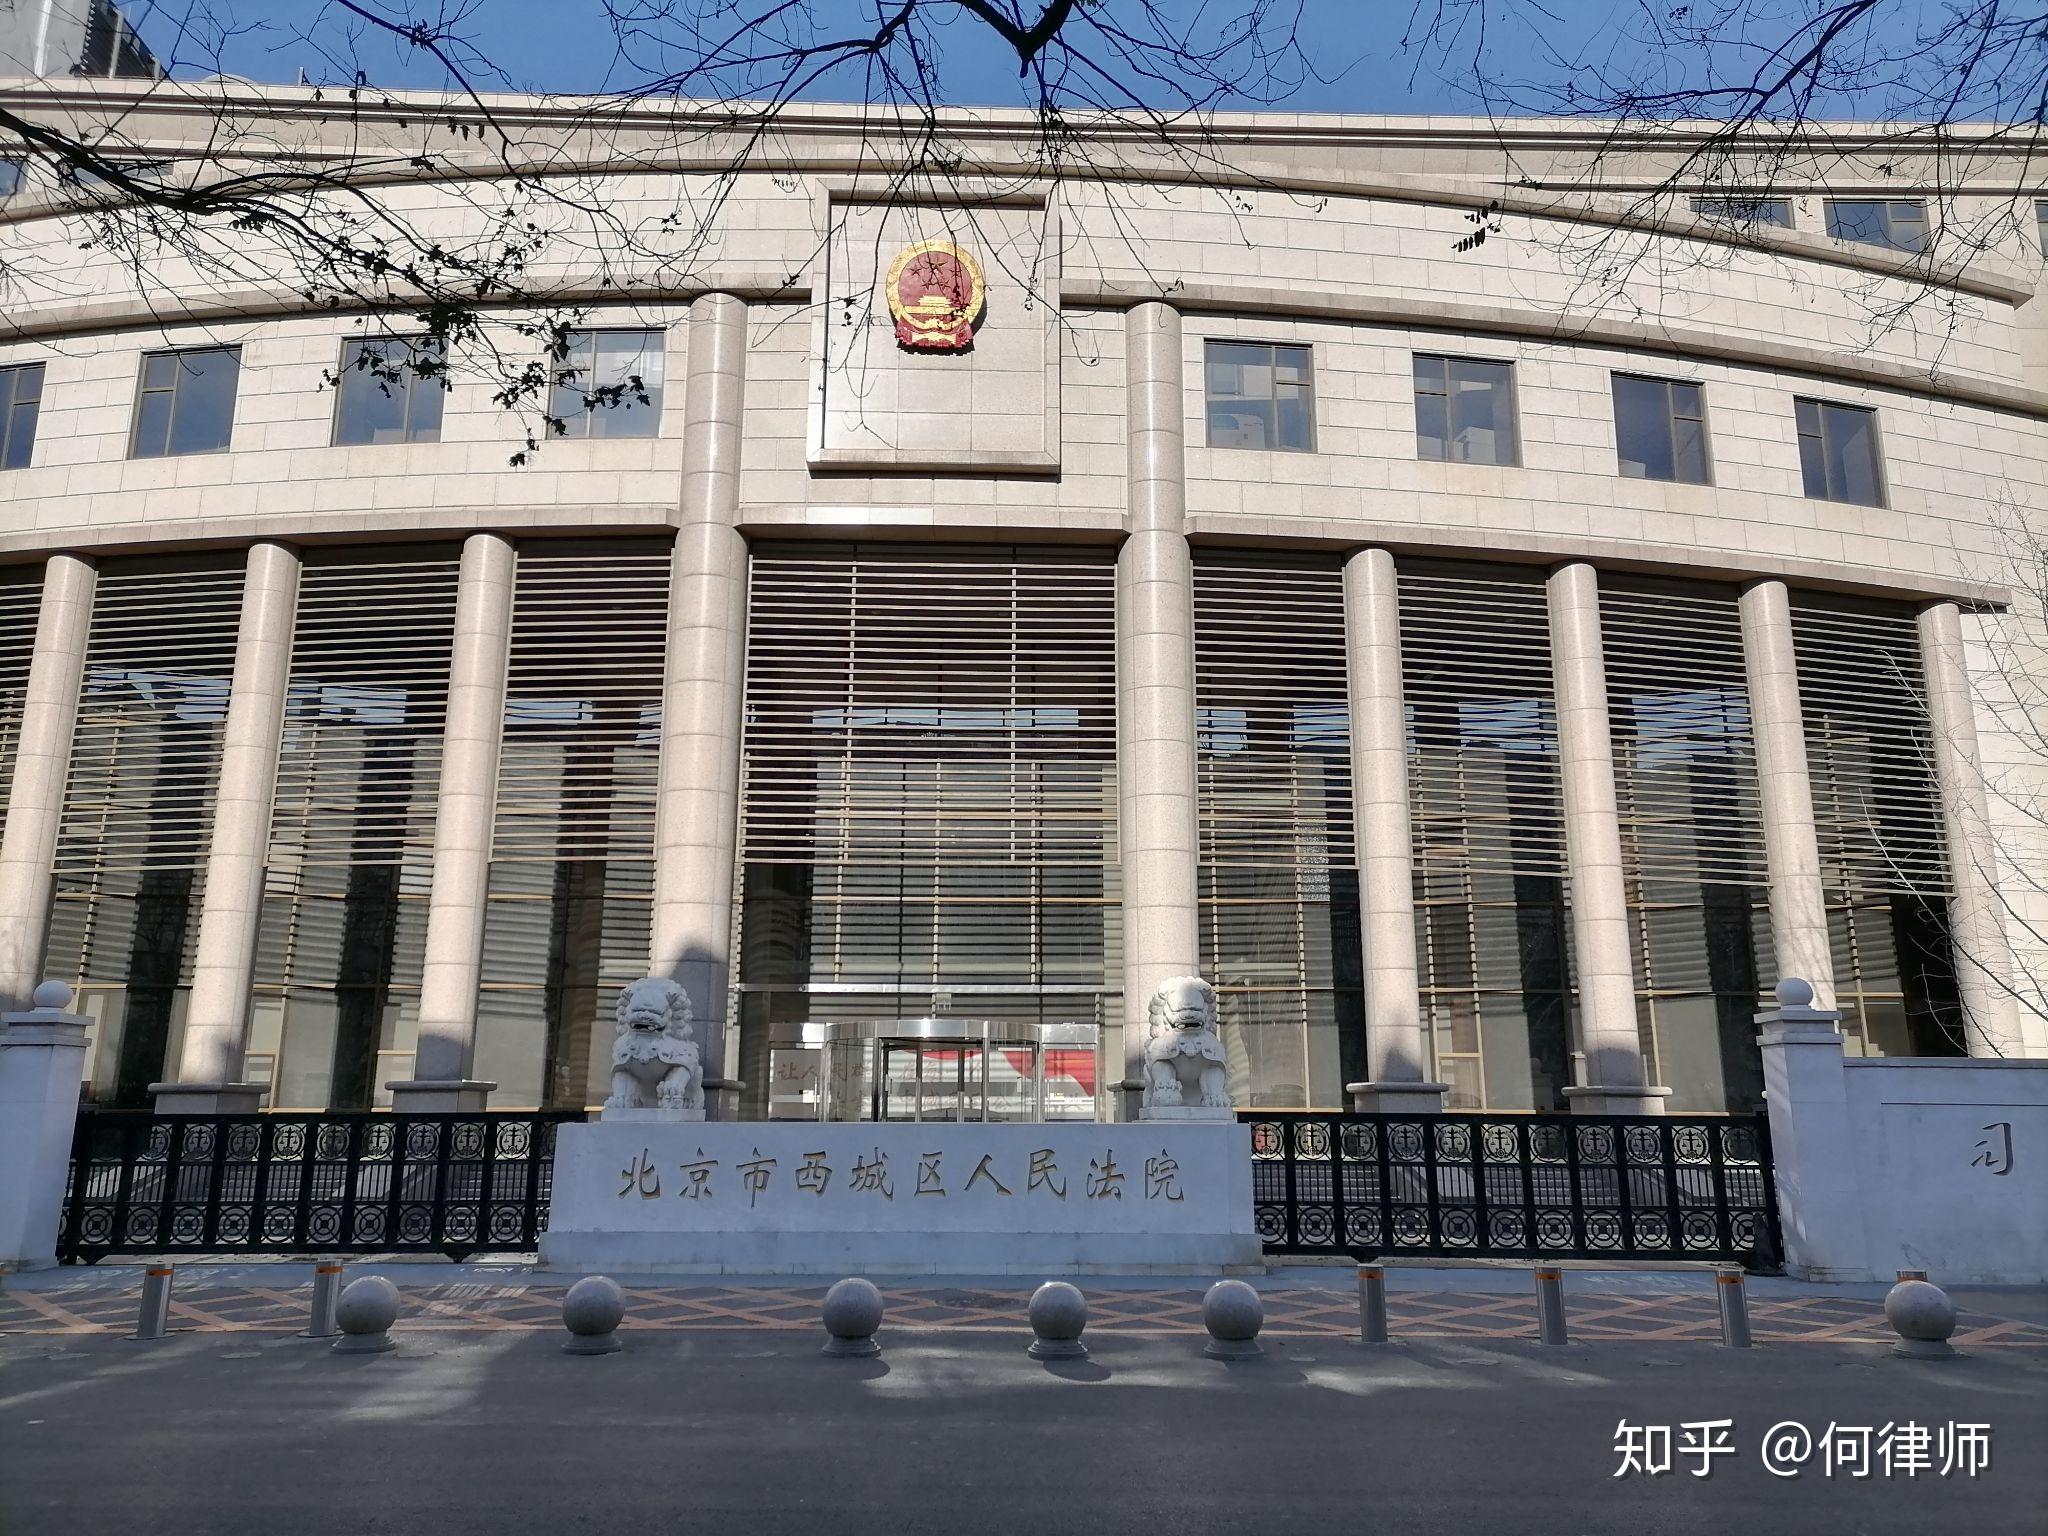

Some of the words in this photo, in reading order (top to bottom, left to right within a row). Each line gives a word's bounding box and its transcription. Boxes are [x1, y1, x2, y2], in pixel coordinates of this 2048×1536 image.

[617, 1146, 1185, 1208] 北京市西城区人民法院
[1970, 1122, 2014, 1176] 司
